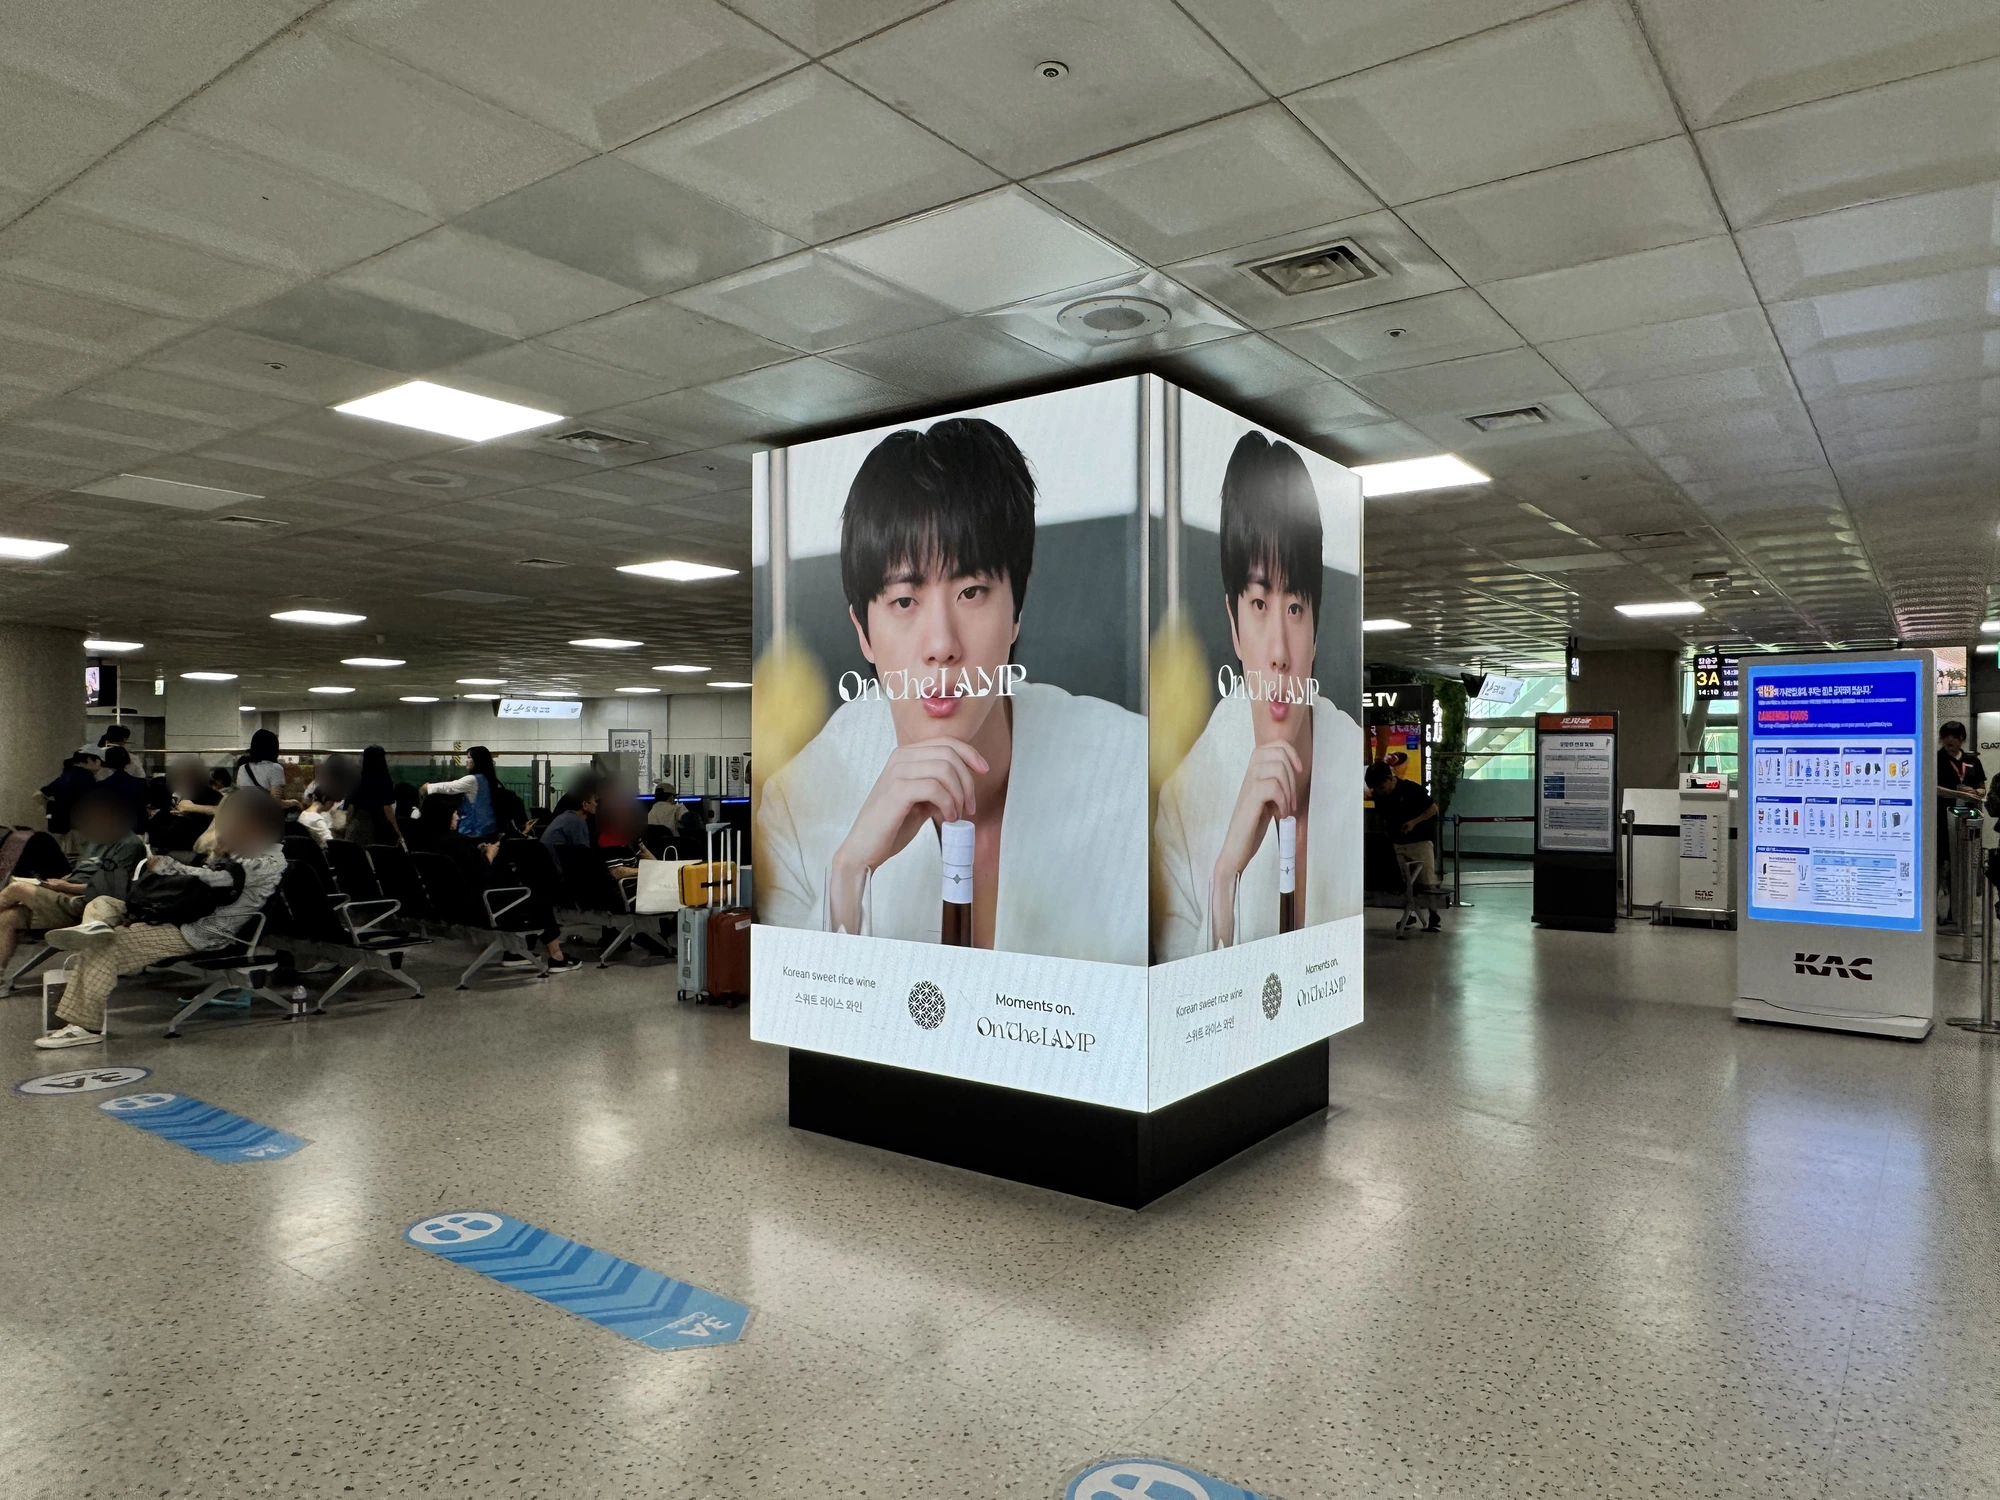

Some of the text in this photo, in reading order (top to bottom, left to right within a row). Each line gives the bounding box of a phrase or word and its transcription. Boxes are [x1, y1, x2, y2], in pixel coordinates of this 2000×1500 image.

[1696, 671, 1720, 686] 3A
[1375, 692, 1398, 707] TV
[782, 966, 876, 989] Korean sweet rice wine
[1305, 960, 1330, 975] Moments
[1793, 952, 1873, 981] KAC
[794, 992, 863, 1013] 스위트 라이스 와인
[995, 993, 1076, 1016] Moments on.
[1175, 987, 1243, 1018] Korean sweet rice wine
[1185, 1015, 1235, 1044] 스위트 라이스 와인
[40, 1071, 131, 1089] 3A
[677, 1315, 732, 1338] 3A
